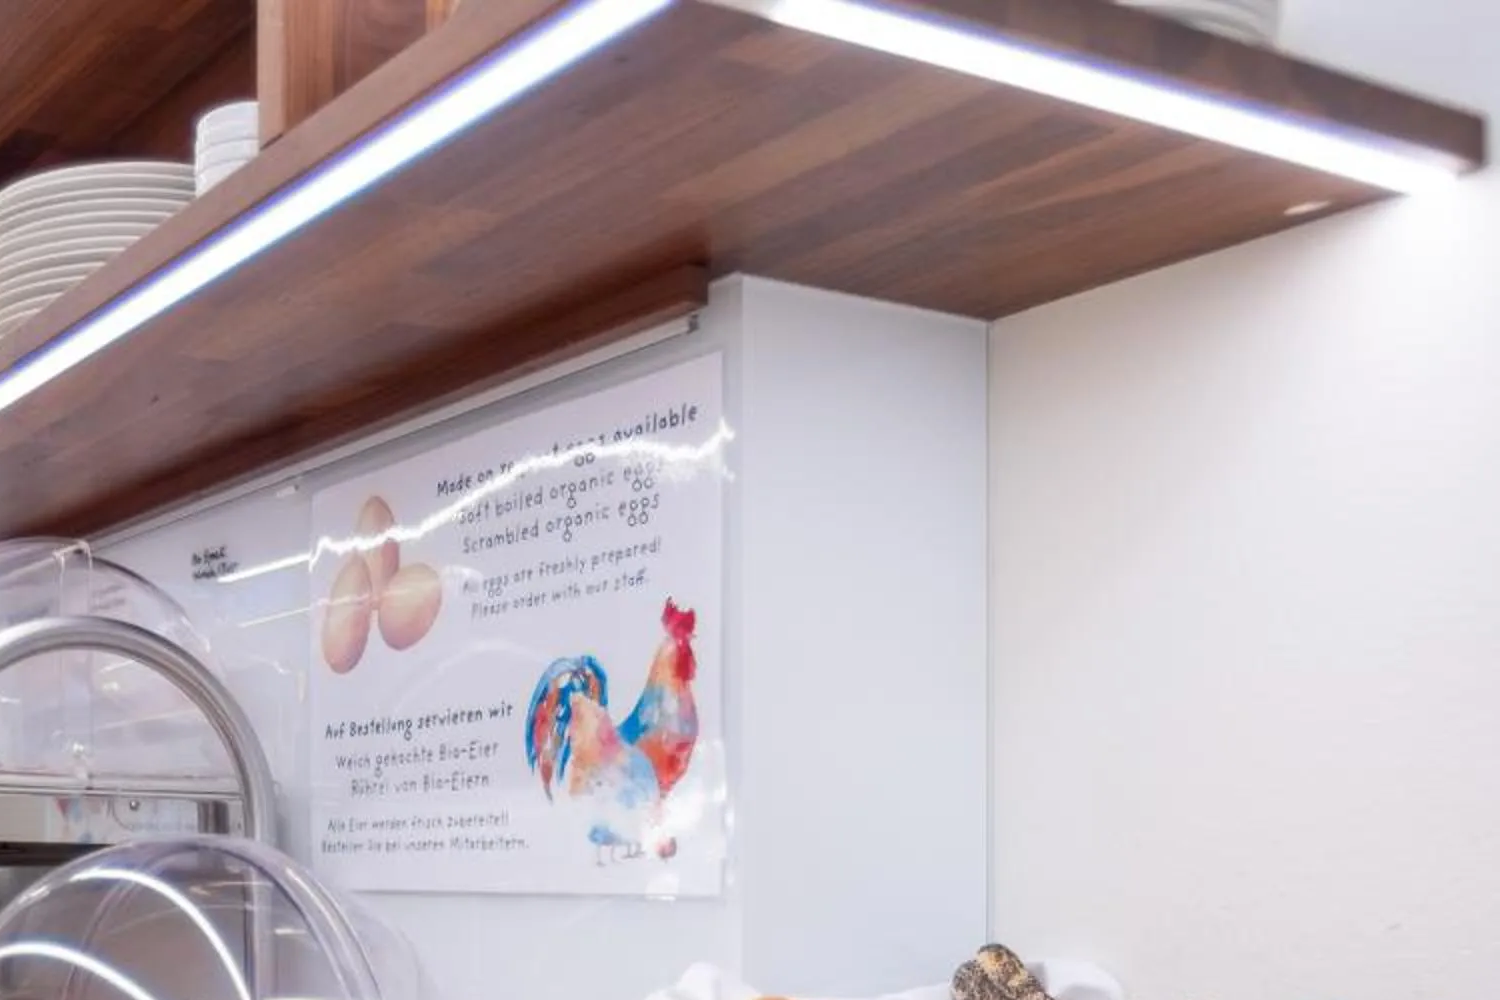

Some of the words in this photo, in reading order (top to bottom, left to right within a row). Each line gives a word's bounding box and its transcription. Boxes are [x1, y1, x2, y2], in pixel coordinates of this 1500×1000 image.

[437, 473, 473, 497] Made
[477, 468, 494, 483] on
[613, 401, 698, 442] available
[495, 486, 544, 516] boiled
[549, 470, 614, 509] organic
[462, 519, 540, 554] Scrambled
[545, 503, 610, 543] organic
[617, 493, 660, 527] eggs
[538, 555, 586, 576] freshly
[325, 721, 346, 741] Auf
[349, 717, 414, 742] Bestellung
[417, 707, 484, 731] servieren
[488, 700, 514, 719] wir
[335, 752, 371, 770] Weich
[373, 744, 434, 779] gekochte
[438, 740, 500, 763] Bio-Eier
[422, 770, 490, 793] Bio-Eiern
